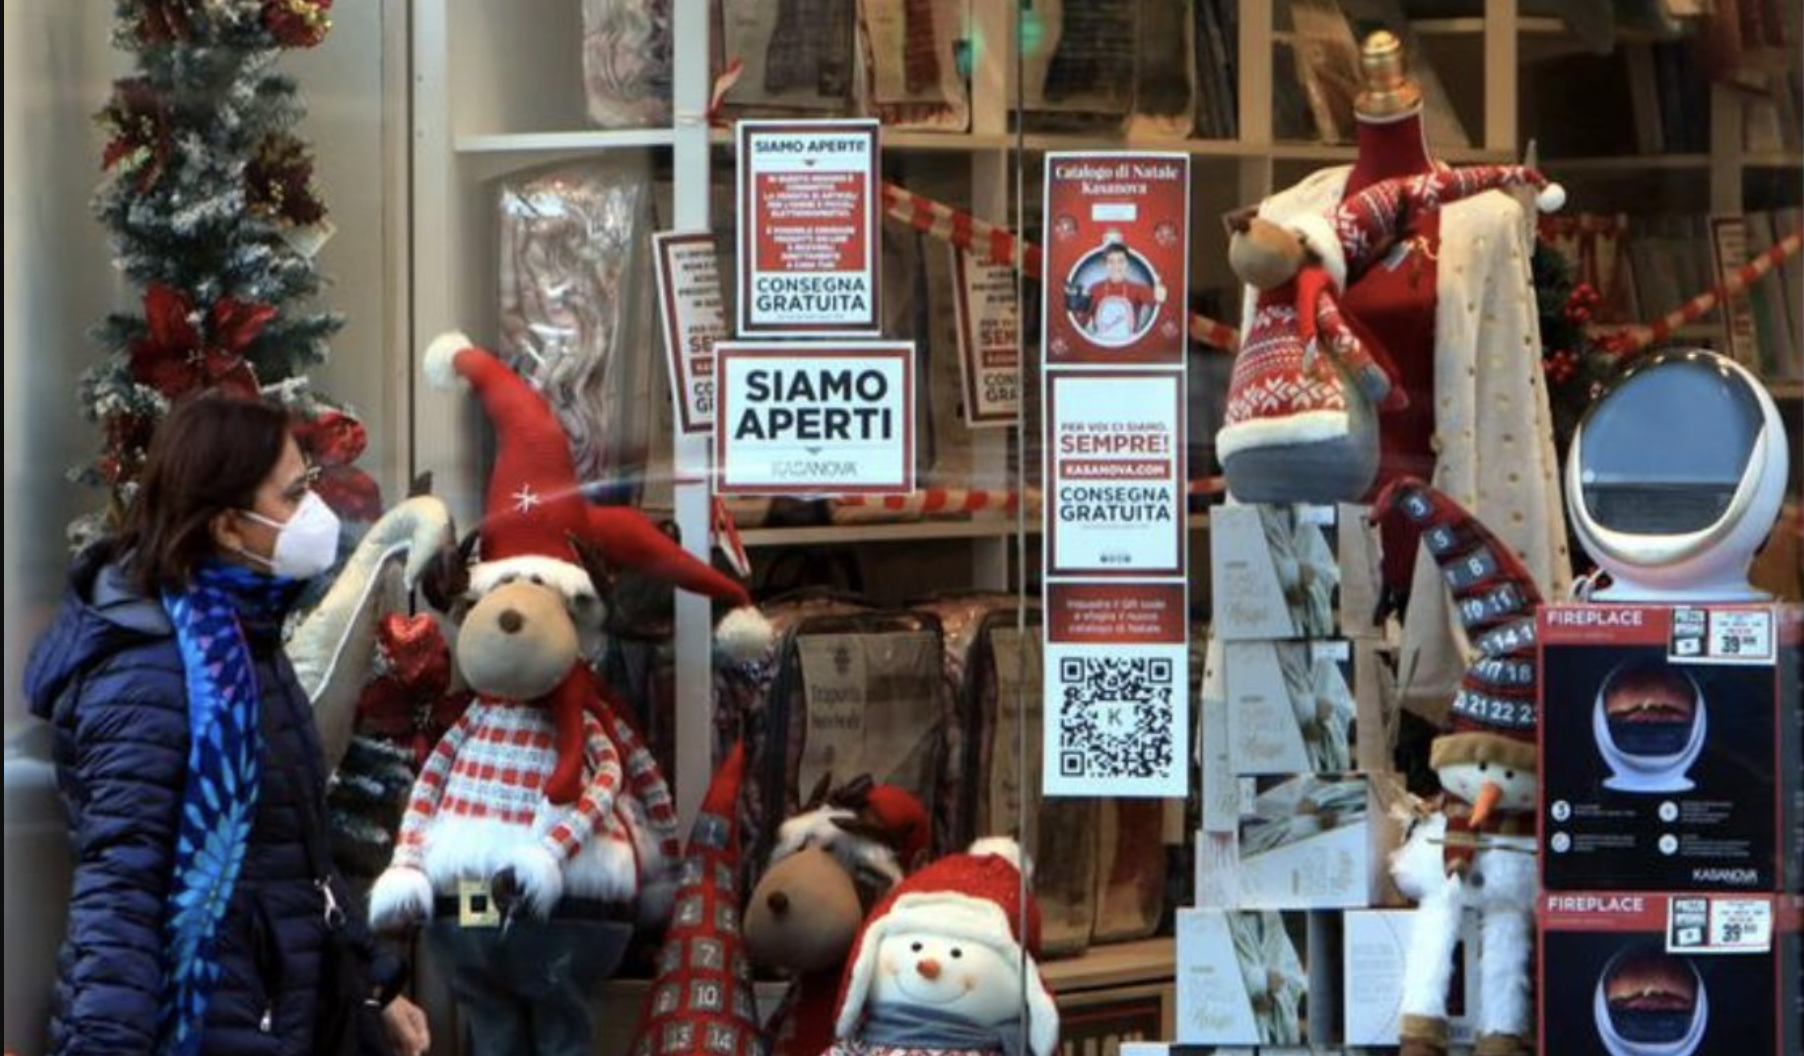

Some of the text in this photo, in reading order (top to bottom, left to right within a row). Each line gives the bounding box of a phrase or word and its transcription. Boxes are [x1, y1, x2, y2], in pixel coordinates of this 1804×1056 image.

[755, 140, 803, 153] SIAMO
[1055, 164, 1179, 182] Catalogo di Natale
[1081, 181, 1147, 195] Kasanova
[757, 277, 865, 293] CONSEGNA
[757, 295, 866, 312] GRATUITA
[745, 369, 888, 402] SIAMO
[735, 408, 891, 440] APERTI
[1060, 434, 1170, 453] SEMPRE!
[1065, 465, 1165, 476] KASANOVA.COM
[1060, 487, 1170, 502] CONSEGNA
[1060, 504, 1171, 521] GRATUITA
[1409, 498, 1425, 516] 3
[1434, 530, 1449, 548] 5
[1468, 557, 1484, 576] 8
[1463, 600, 1483, 621] 10
[1547, 611, 1643, 626] FIREPLACE
[1721, 636, 1741, 654] 39
[1108, 708, 1123, 726] K
[1490, 700, 1515, 721] 22
[1519, 704, 1537, 723] 2
[1692, 868, 1758, 883] KASANOVA
[1547, 897, 1644, 912] FIREPLACE
[1722, 923, 1741, 942] 39
[701, 944, 716, 966] 7
[697, 986, 718, 1006] 10
